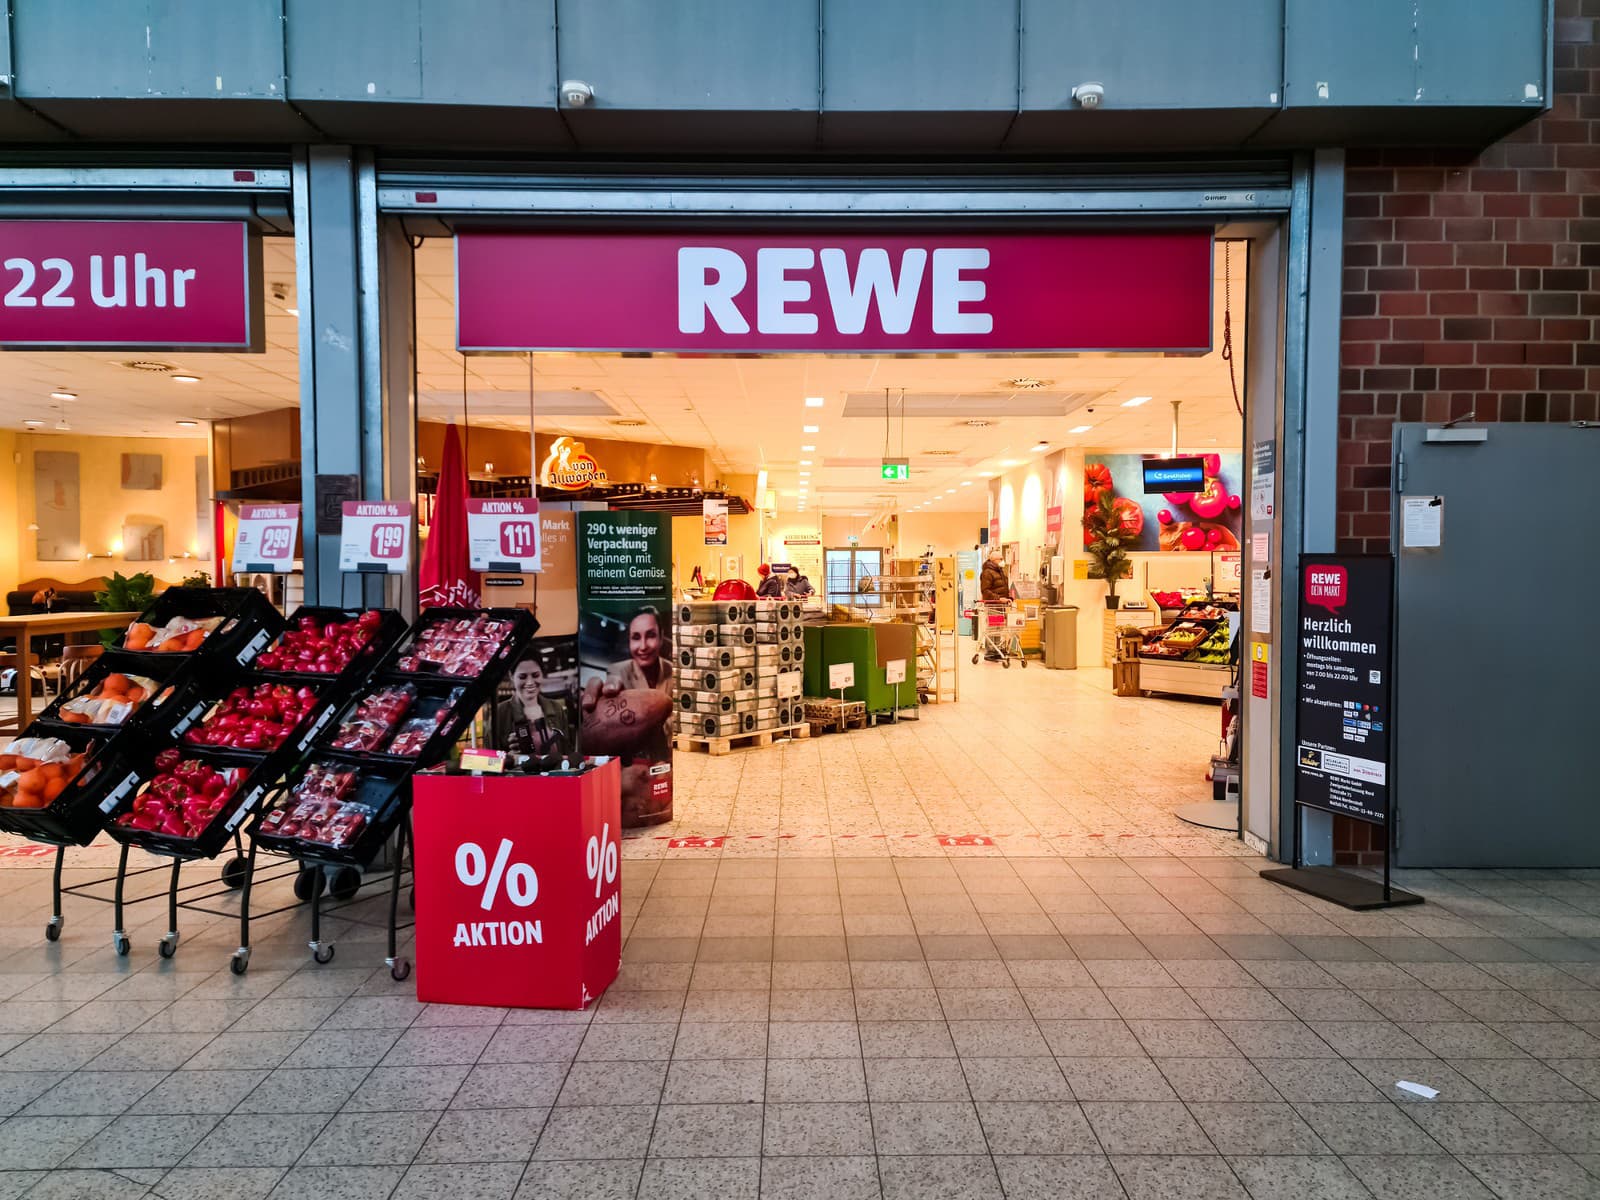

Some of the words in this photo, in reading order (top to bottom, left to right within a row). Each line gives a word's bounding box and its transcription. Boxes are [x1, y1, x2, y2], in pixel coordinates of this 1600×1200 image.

[3, 257, 76, 308] 22
[89, 252, 197, 310] Uhr
[678, 246, 995, 336] REWE
[572, 461, 593, 471] von
[250, 508, 277, 518] AKTION
[277, 508, 287, 518] %
[356, 505, 387, 516] AKTION
[387, 505, 398, 516] %
[482, 502, 512, 513] AKTION
[513, 502, 525, 513] %
[542, 519, 570, 530] Markt
[586, 523, 606, 535] 290
[608, 525, 614, 535] t
[616, 523, 658, 537] weniger
[262, 529, 290, 556] 2.99
[374, 526, 403, 556] 1.99
[559, 534, 567, 543] in
[587, 537, 648, 551] Verpackung
[587, 552, 632, 566] beginnen
[635, 552, 651, 563] mit
[587, 567, 625, 578] meinem
[629, 566, 666, 578] Gemüse.
[1311, 573, 1341, 584] REWE
[1311, 585, 1322, 595] DEIN
[1324, 585, 1340, 596] MARKT
[1304, 617, 1352, 634] Herzlich
[1303, 635, 1377, 654] willkommen
[586, 822, 618, 898] %
[455, 838, 538, 912] %
[585, 890, 619, 947] AKTION
[453, 920, 543, 948] AKTION
